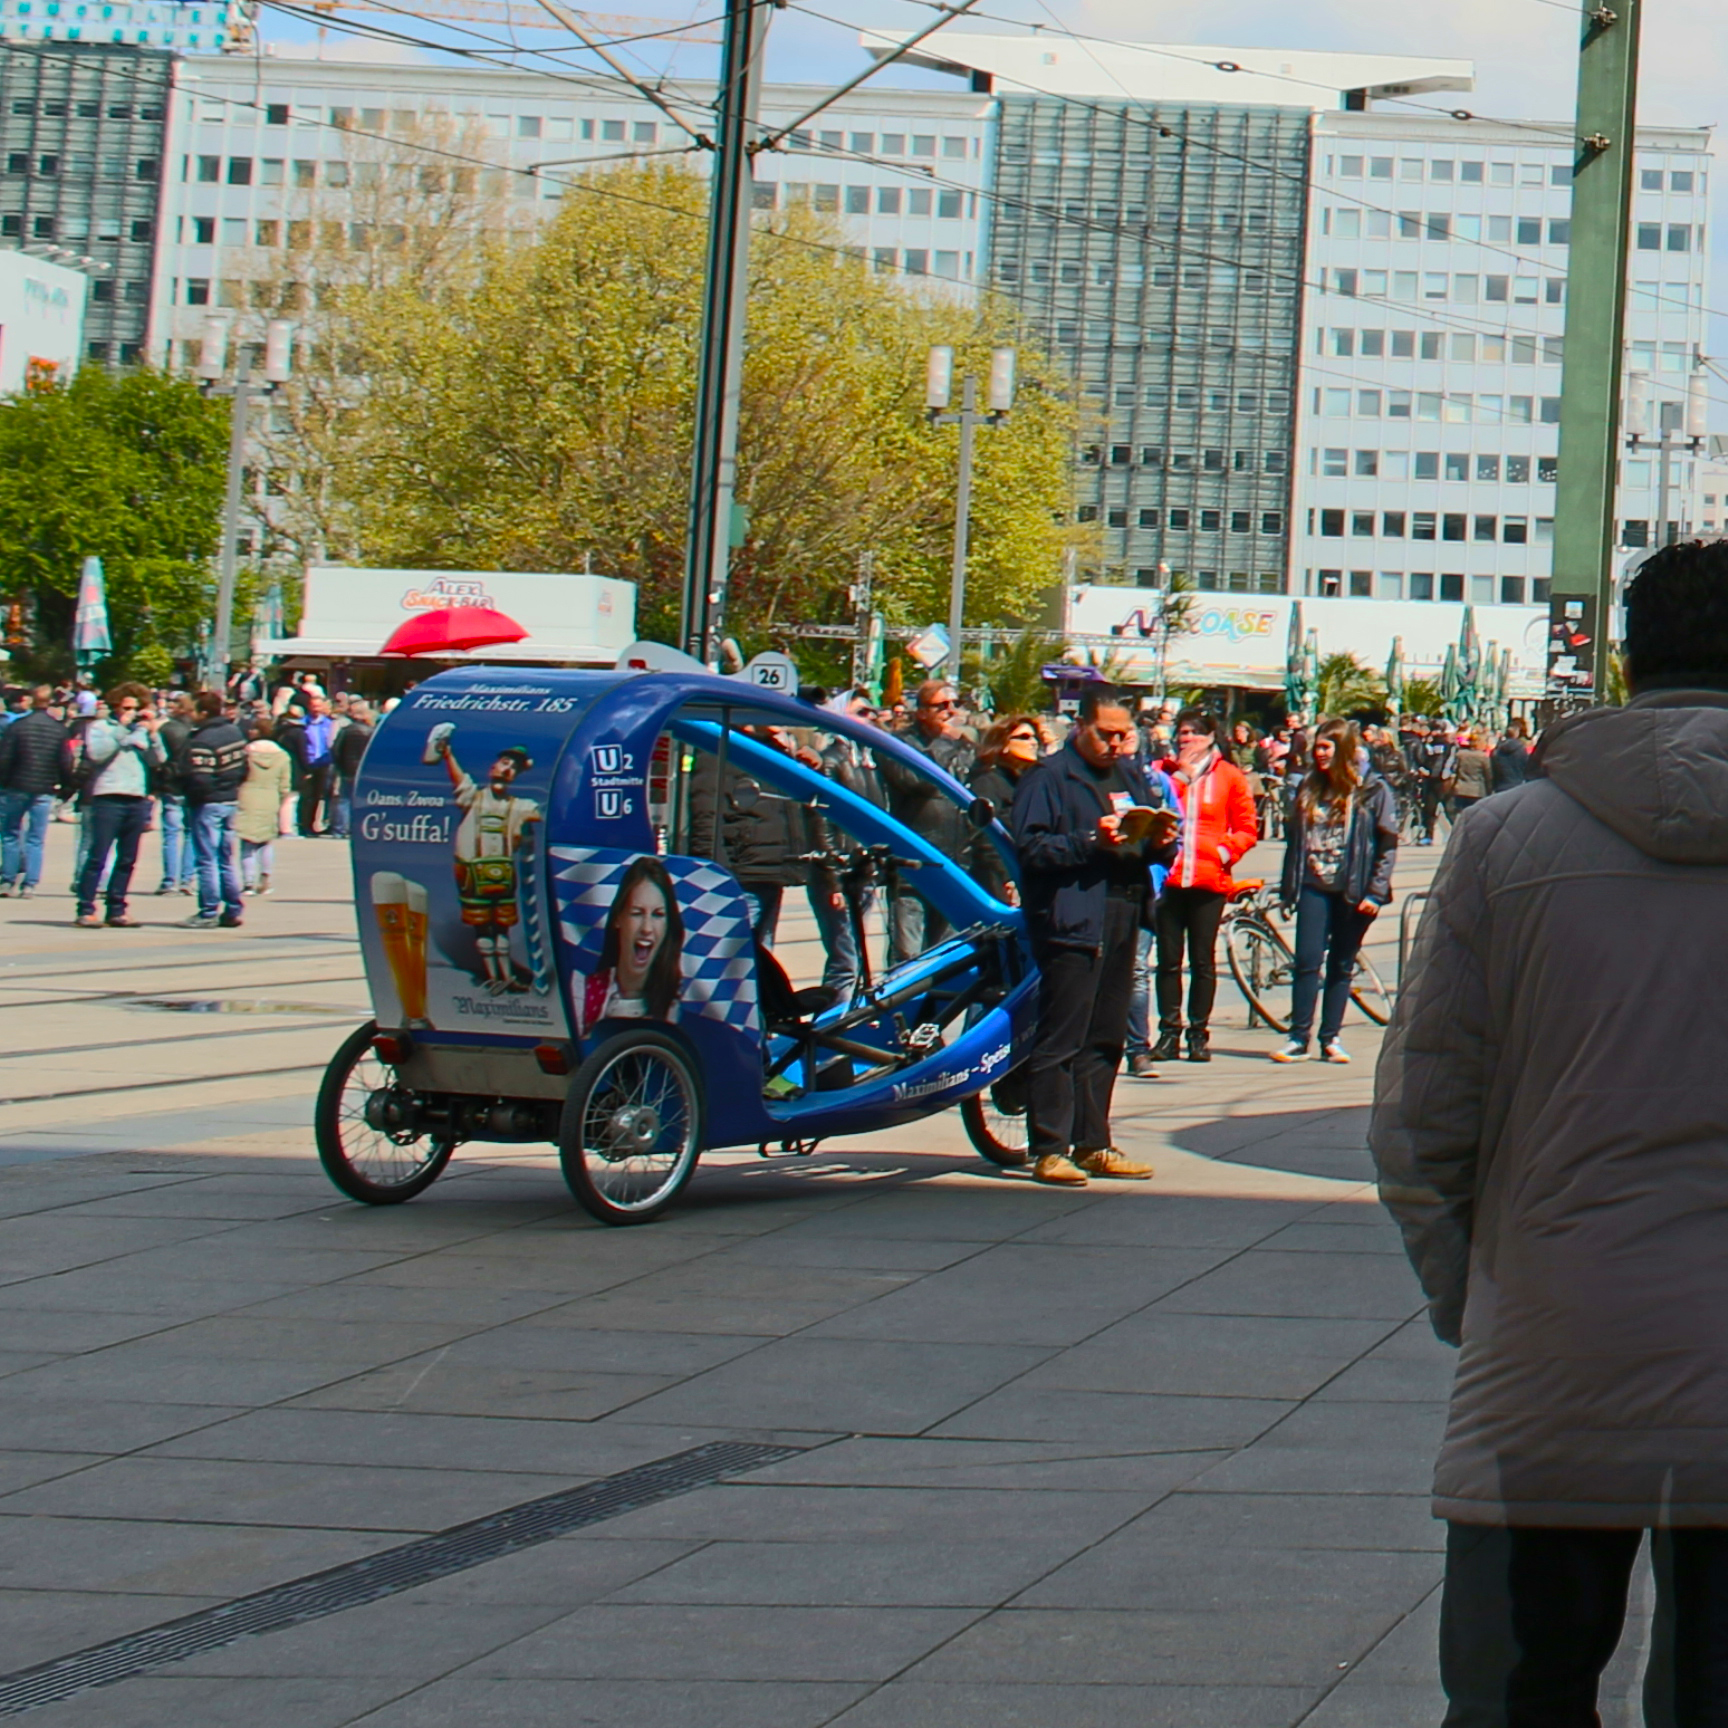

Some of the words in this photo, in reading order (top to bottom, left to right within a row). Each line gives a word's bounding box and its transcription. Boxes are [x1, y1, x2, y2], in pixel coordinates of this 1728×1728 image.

[759, 668, 780, 685] 26
[412, 693, 530, 711] Friedrichstr.
[534, 697, 578, 713] 185
[598, 748, 617, 771] U
[623, 753, 634, 770] 2
[591, 776, 644, 787] Stadtmitte
[367, 789, 405, 807] Oans,
[407, 790, 445, 807] Zwoa
[602, 792, 618, 816] U
[623, 797, 633, 815] 6
[362, 812, 450, 843] G'suffa!
[892, 1068, 970, 1102] Maximilians
